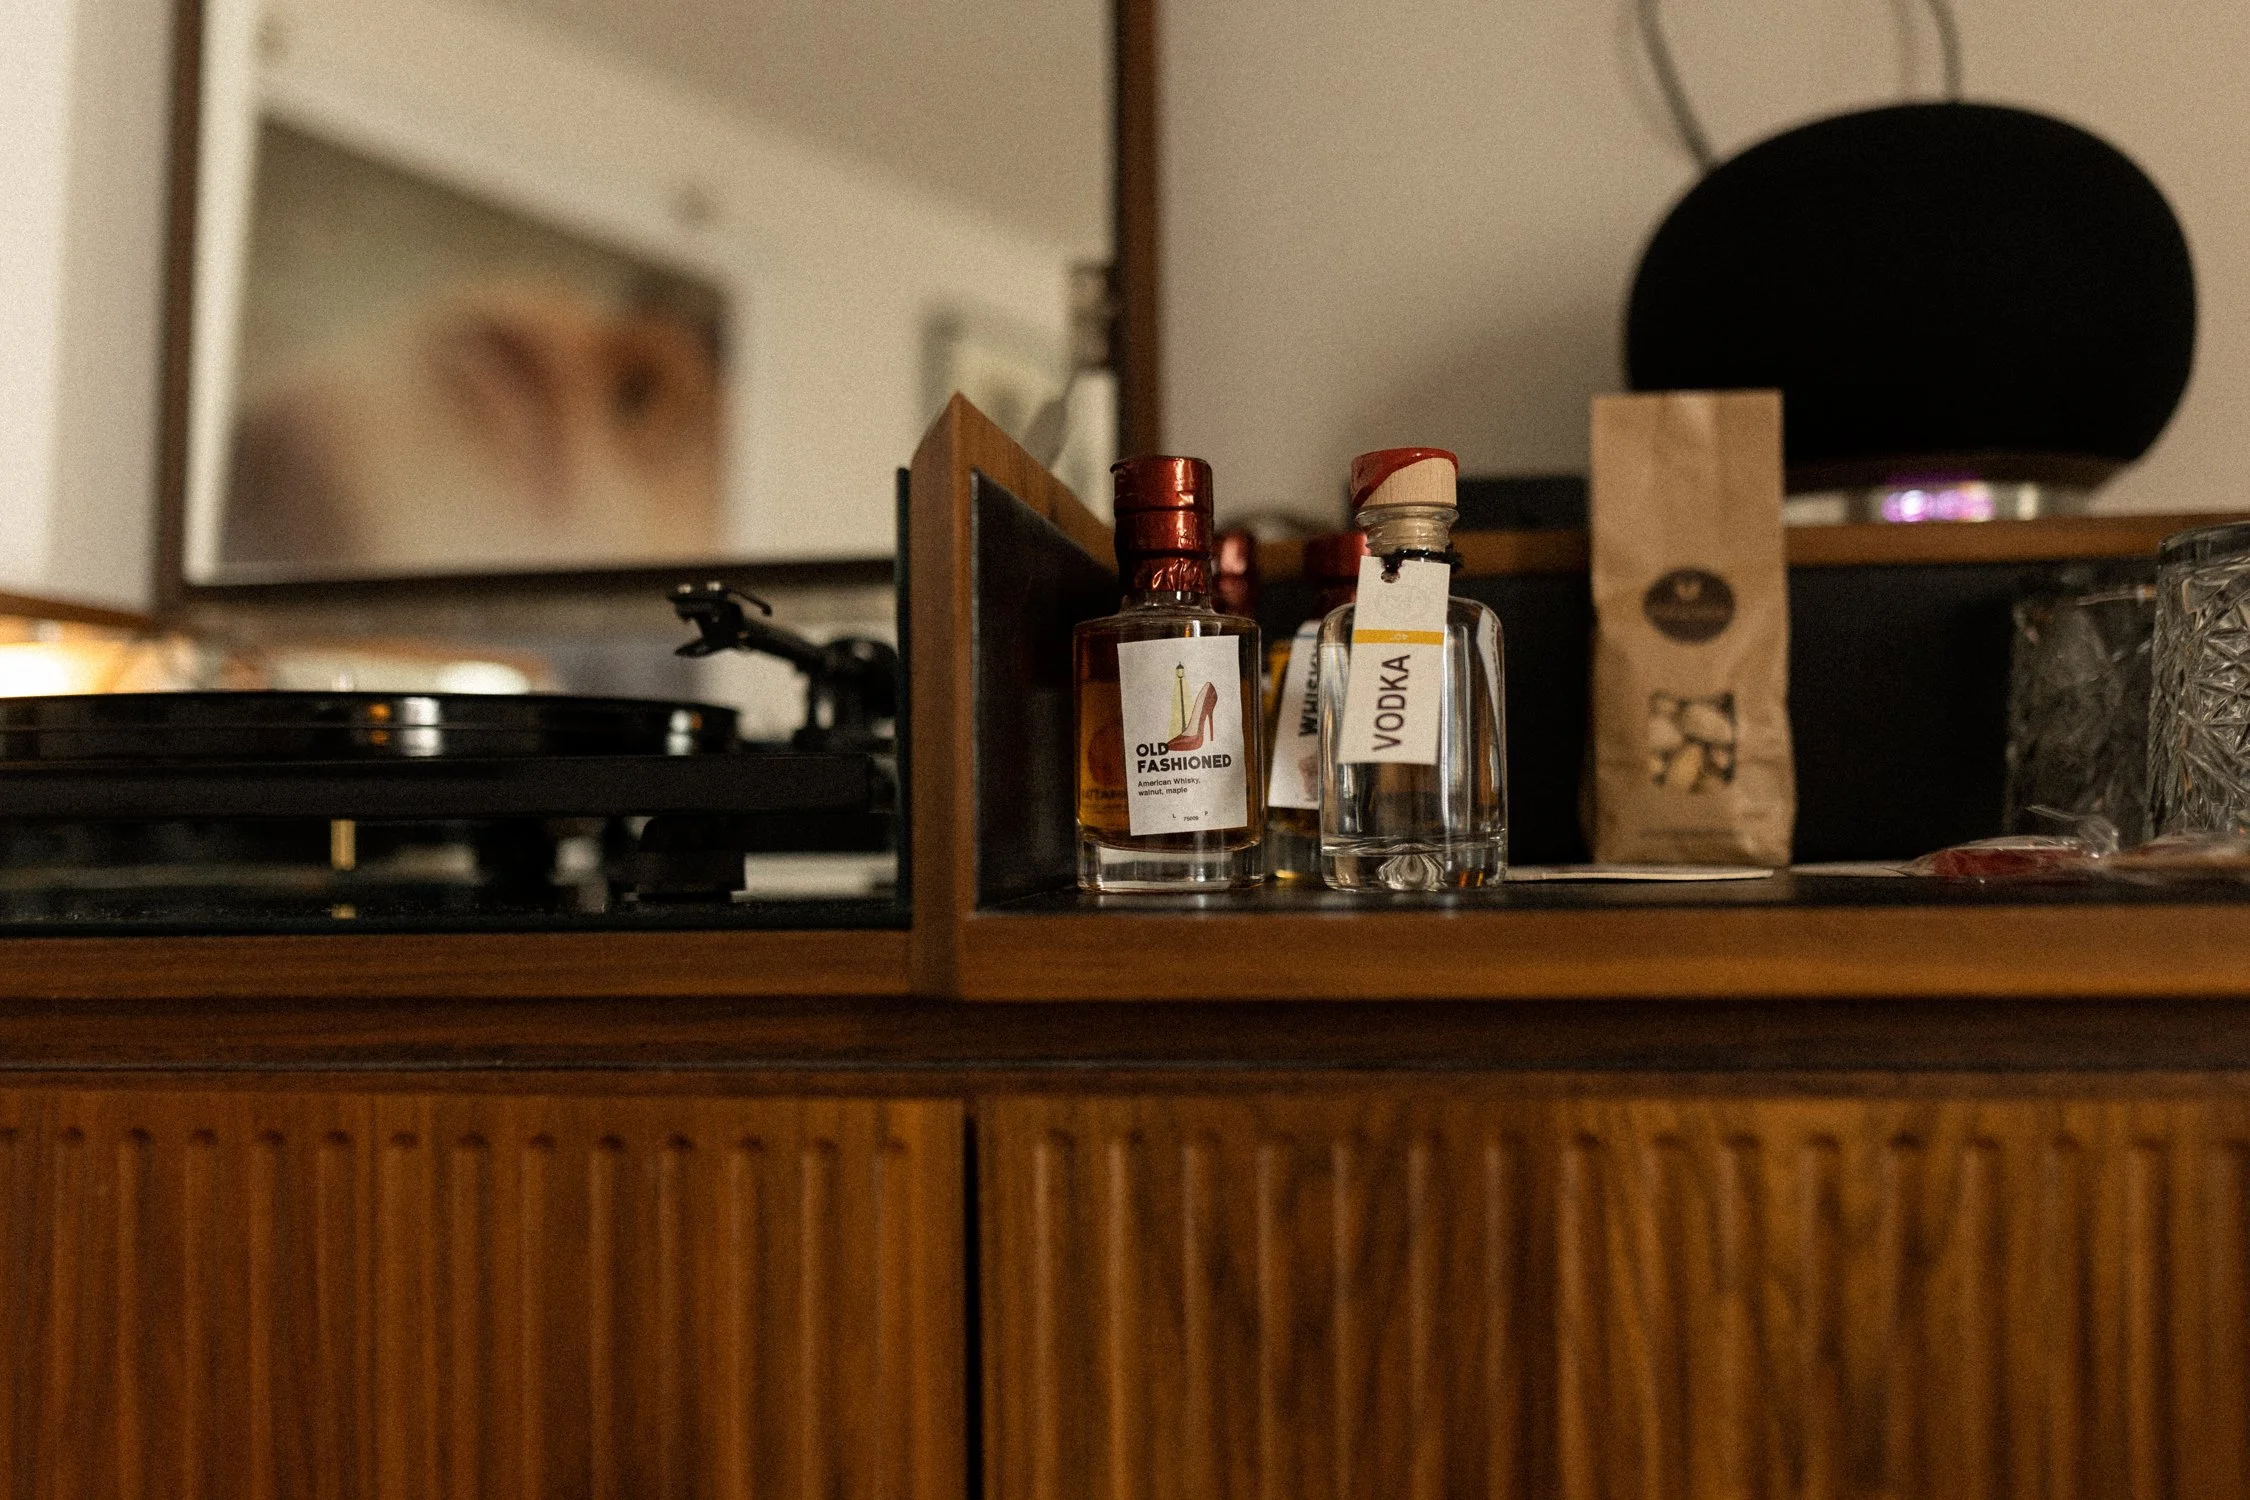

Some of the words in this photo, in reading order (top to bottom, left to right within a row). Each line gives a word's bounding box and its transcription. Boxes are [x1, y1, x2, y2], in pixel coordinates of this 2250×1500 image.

[1372, 654, 1411, 752] VODKA
[1136, 743, 1169, 757] OLD
[1137, 754, 1232, 773] FASHIONED
[1138, 779, 1172, 788] American
[1166, 787, 1188, 795] maple
